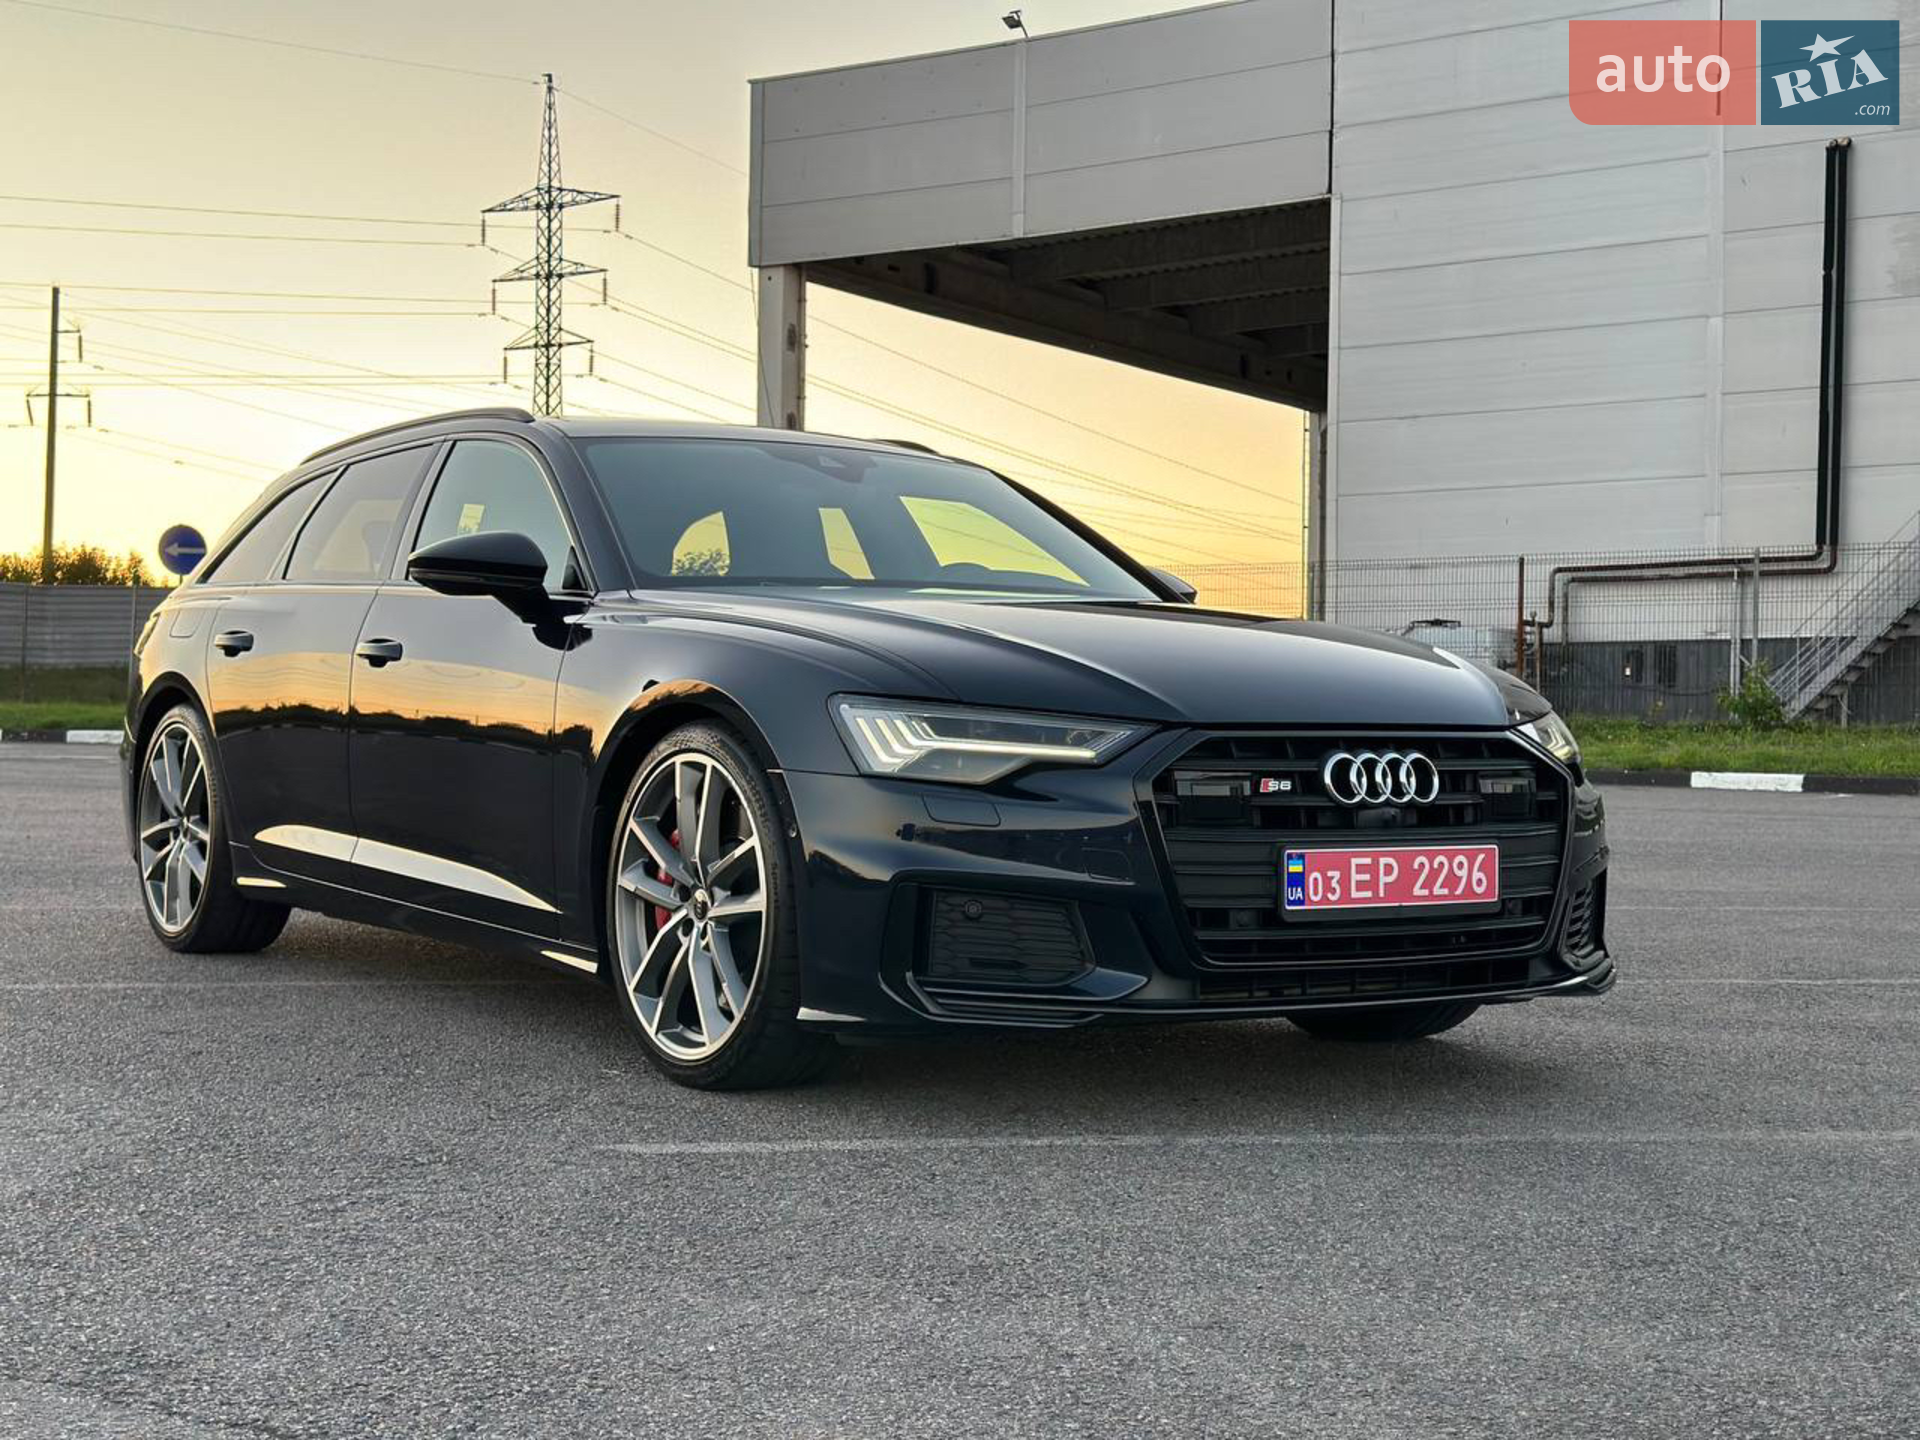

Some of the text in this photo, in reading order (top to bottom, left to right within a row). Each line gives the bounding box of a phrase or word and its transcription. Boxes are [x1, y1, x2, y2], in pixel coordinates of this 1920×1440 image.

[1308, 853, 1488, 901] 03 EP 2296
[1288, 887, 1303, 901] UA
